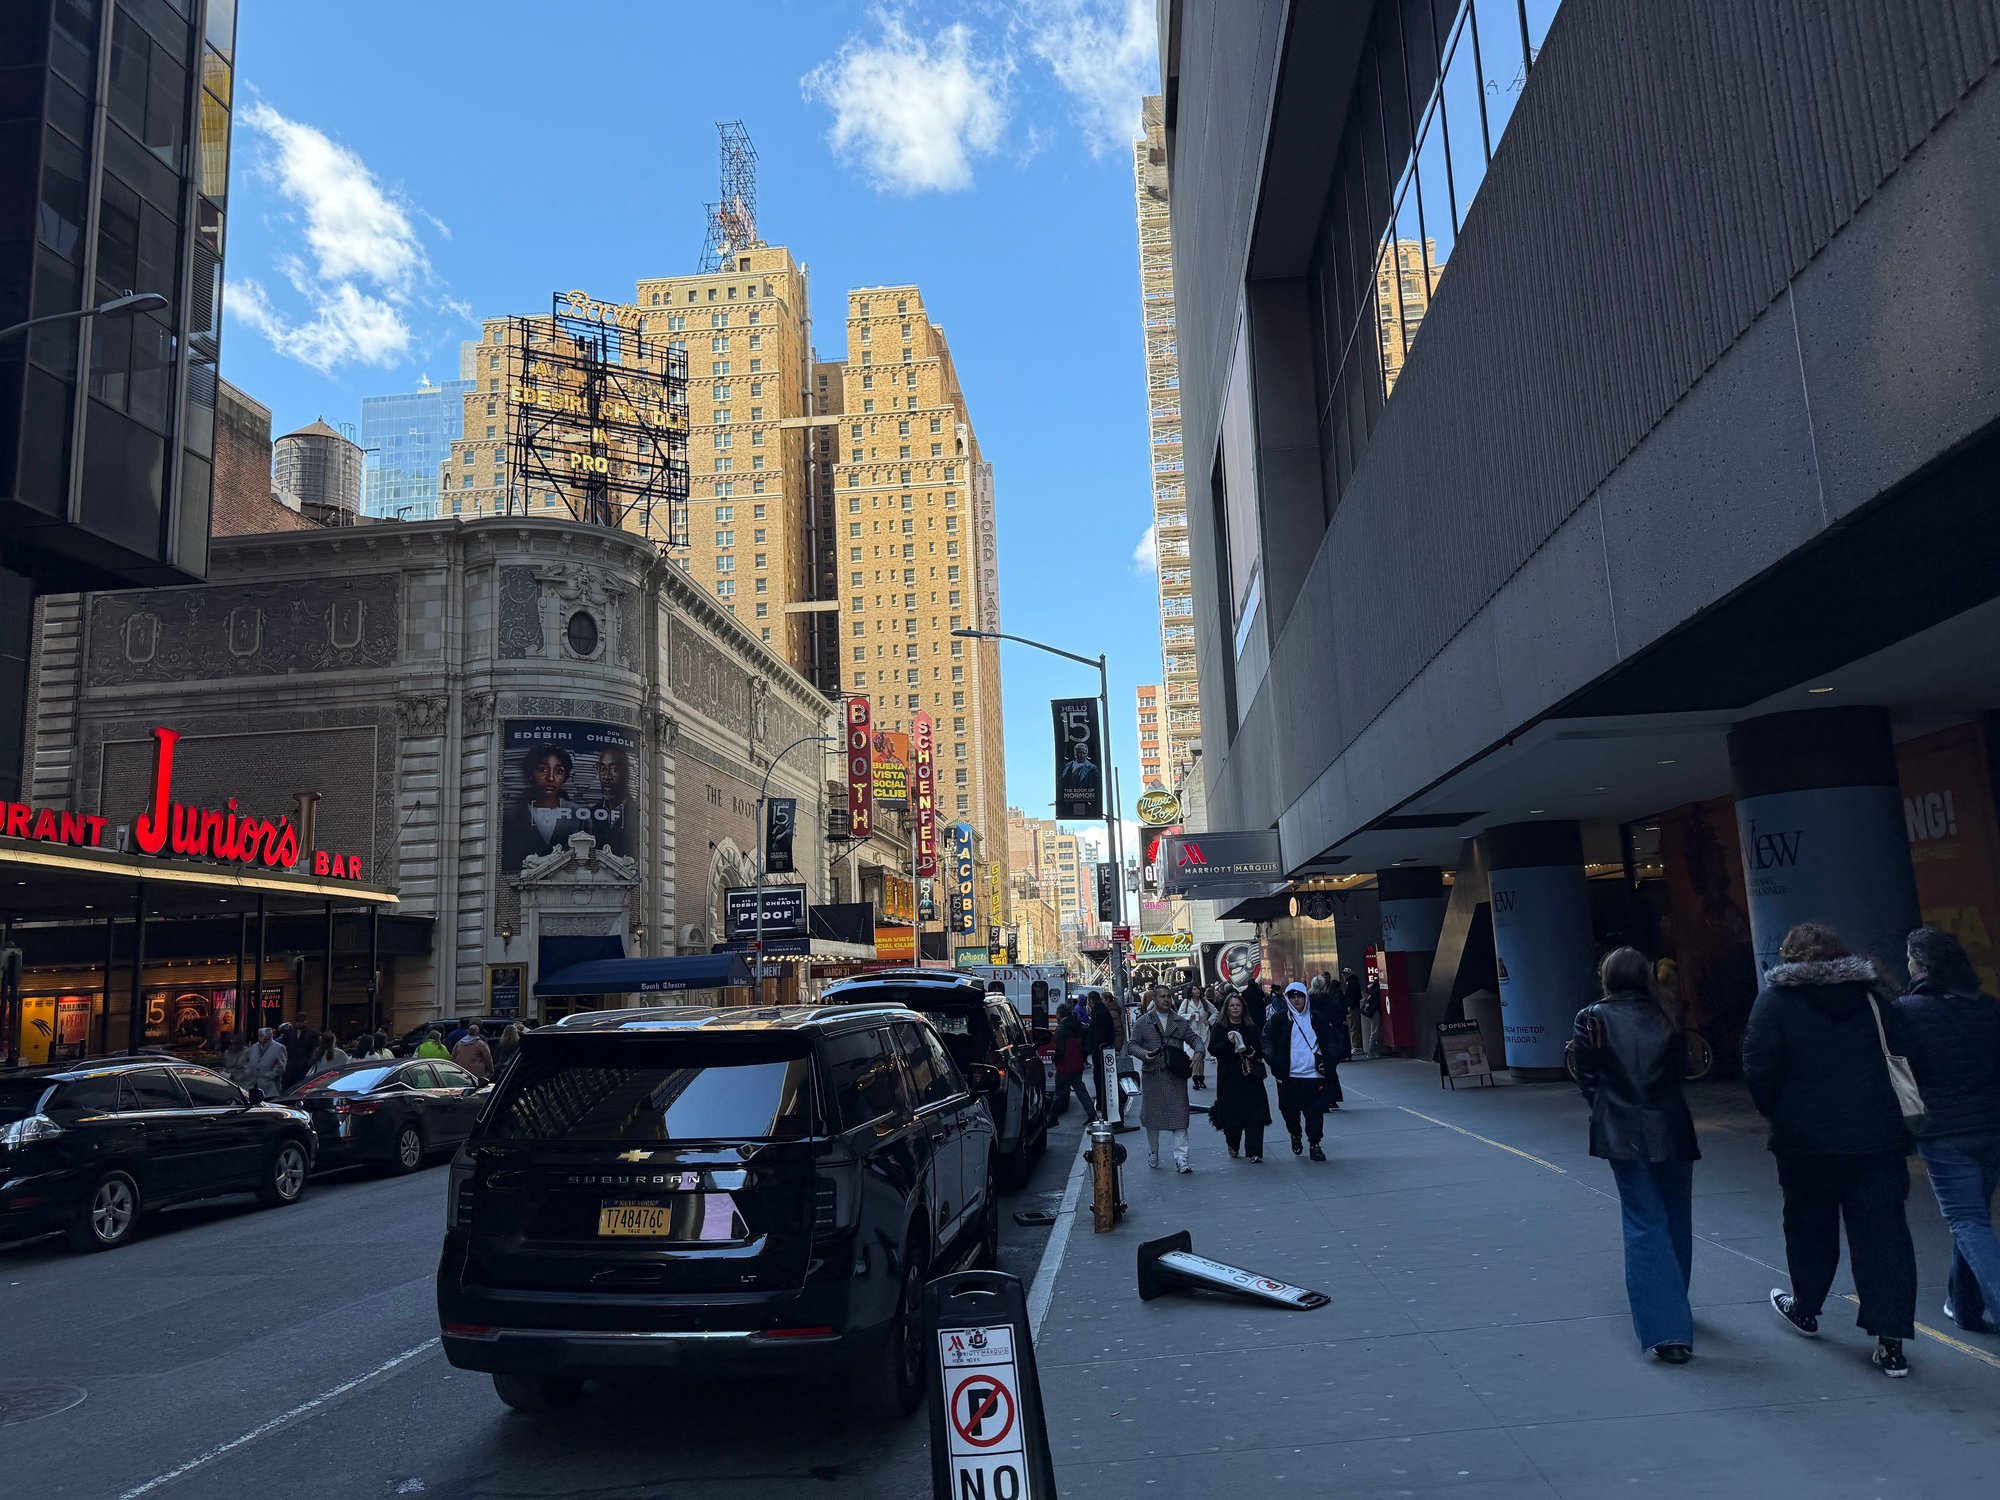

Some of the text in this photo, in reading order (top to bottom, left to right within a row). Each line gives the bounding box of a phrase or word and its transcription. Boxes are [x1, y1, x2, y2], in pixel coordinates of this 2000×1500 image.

[559, 289, 642, 330] Booth
[509, 385, 589, 413] EDEBIRI
[601, 401, 689, 431] CHEADLE
[570, 452, 637, 477] PROOF
[977, 463, 994, 562] MILFORD
[514, 732, 572, 740] EDEBIRI
[1060, 711, 1091, 743] 15
[586, 734, 635, 748] CHEADLE
[850, 704, 869, 830] BOOTH
[872, 762, 905, 771] BUENA
[873, 771, 906, 780] VISTA
[873, 780, 906, 788] SOCIAL
[873, 789, 907, 798] CLUB
[136, 726, 299, 868] Junior's
[705, 784, 722, 807] THE
[917, 721, 933, 870] SCHOENFELD
[1140, 794, 1173, 810] Music
[772, 805, 790, 825] 15
[1147, 806, 1174, 821] Box
[314, 850, 362, 881] BAR
[1185, 863, 1278, 875] MARRIOTT MARQUIS
[920, 880, 931, 894] 15
[960, 831, 973, 928] JACOBS
[991, 864, 1001, 926] GOLDEN
[1136, 933, 1169, 953] Music
[1171, 932, 1190, 952] Box
[824, 967, 850, 977] MARCH 31
[641, 981, 687, 990] Booth Theatre
[145, 999, 166, 1025] 15
[1448, 1022, 1467, 1030] OPEN
[1516, 1026, 1529, 1034] THE
[1529, 1026, 1545, 1034] TOP
[1511, 1036, 1531, 1044] FLOOR
[1532, 1036, 1537, 1044] 3
[568, 1175, 700, 1184] SUBURBAN
[607, 1209, 664, 1229] T748476C
[740, 1275, 757, 1283] LT
[959, 1464, 1020, 1500] NO
